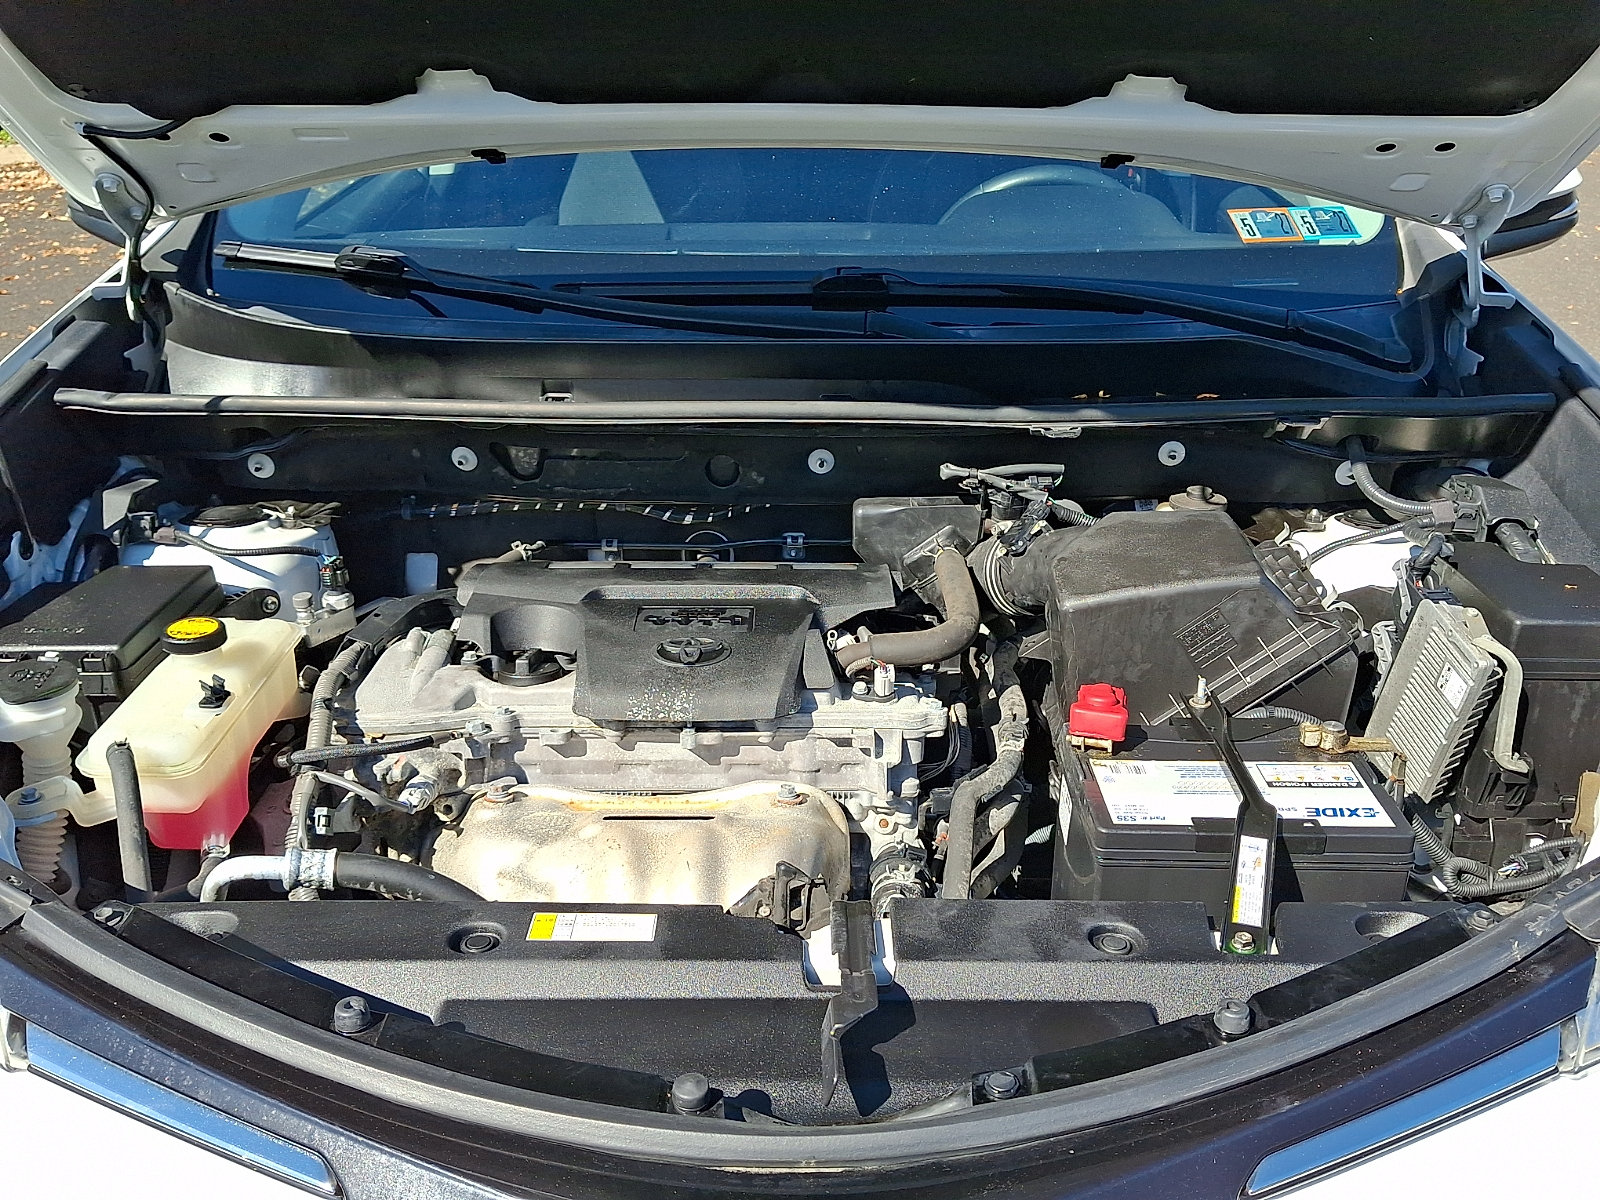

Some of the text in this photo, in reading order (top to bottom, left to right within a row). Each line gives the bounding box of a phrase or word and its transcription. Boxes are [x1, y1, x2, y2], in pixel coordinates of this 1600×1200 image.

[1240, 218, 1256, 237] 5
[1300, 215, 1316, 235] 5
[1305, 807, 1379, 818] EXIDE
